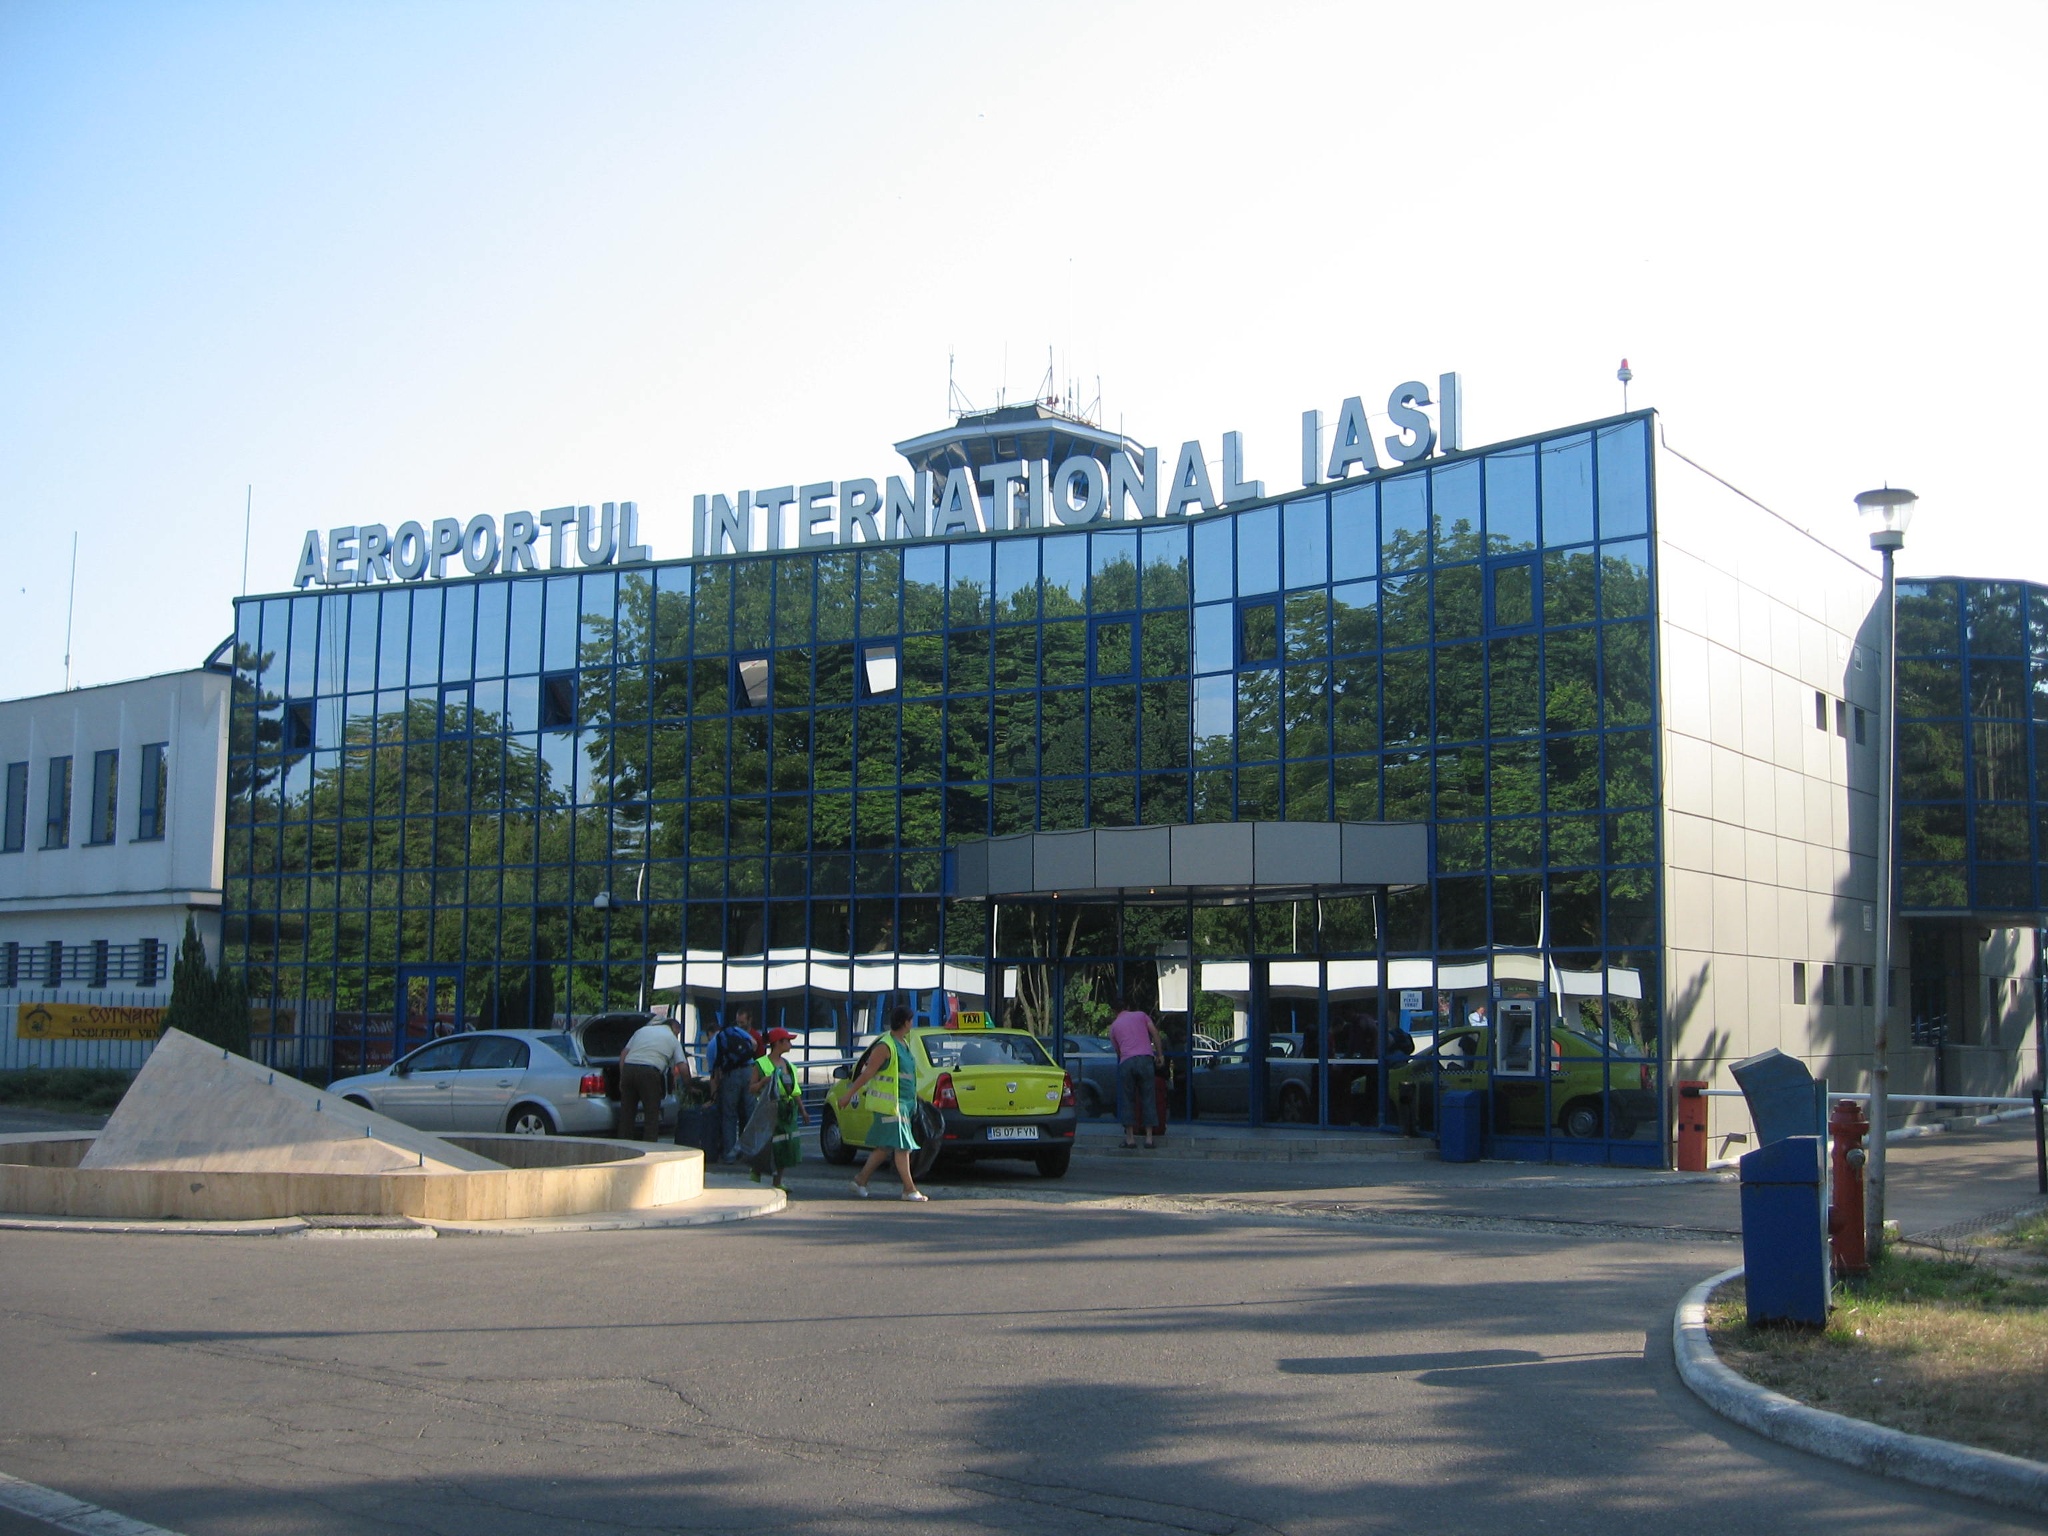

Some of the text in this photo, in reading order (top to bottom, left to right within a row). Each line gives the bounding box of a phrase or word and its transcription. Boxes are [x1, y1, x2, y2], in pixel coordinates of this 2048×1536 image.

[293, 371, 1463, 588] AEROPORTUL INTERNATIONAL IASI
[88, 1006, 161, 1024] COTNARI
[962, 1013, 980, 1024] TAXI
[992, 1127, 1036, 1137] IS 07 FYN
